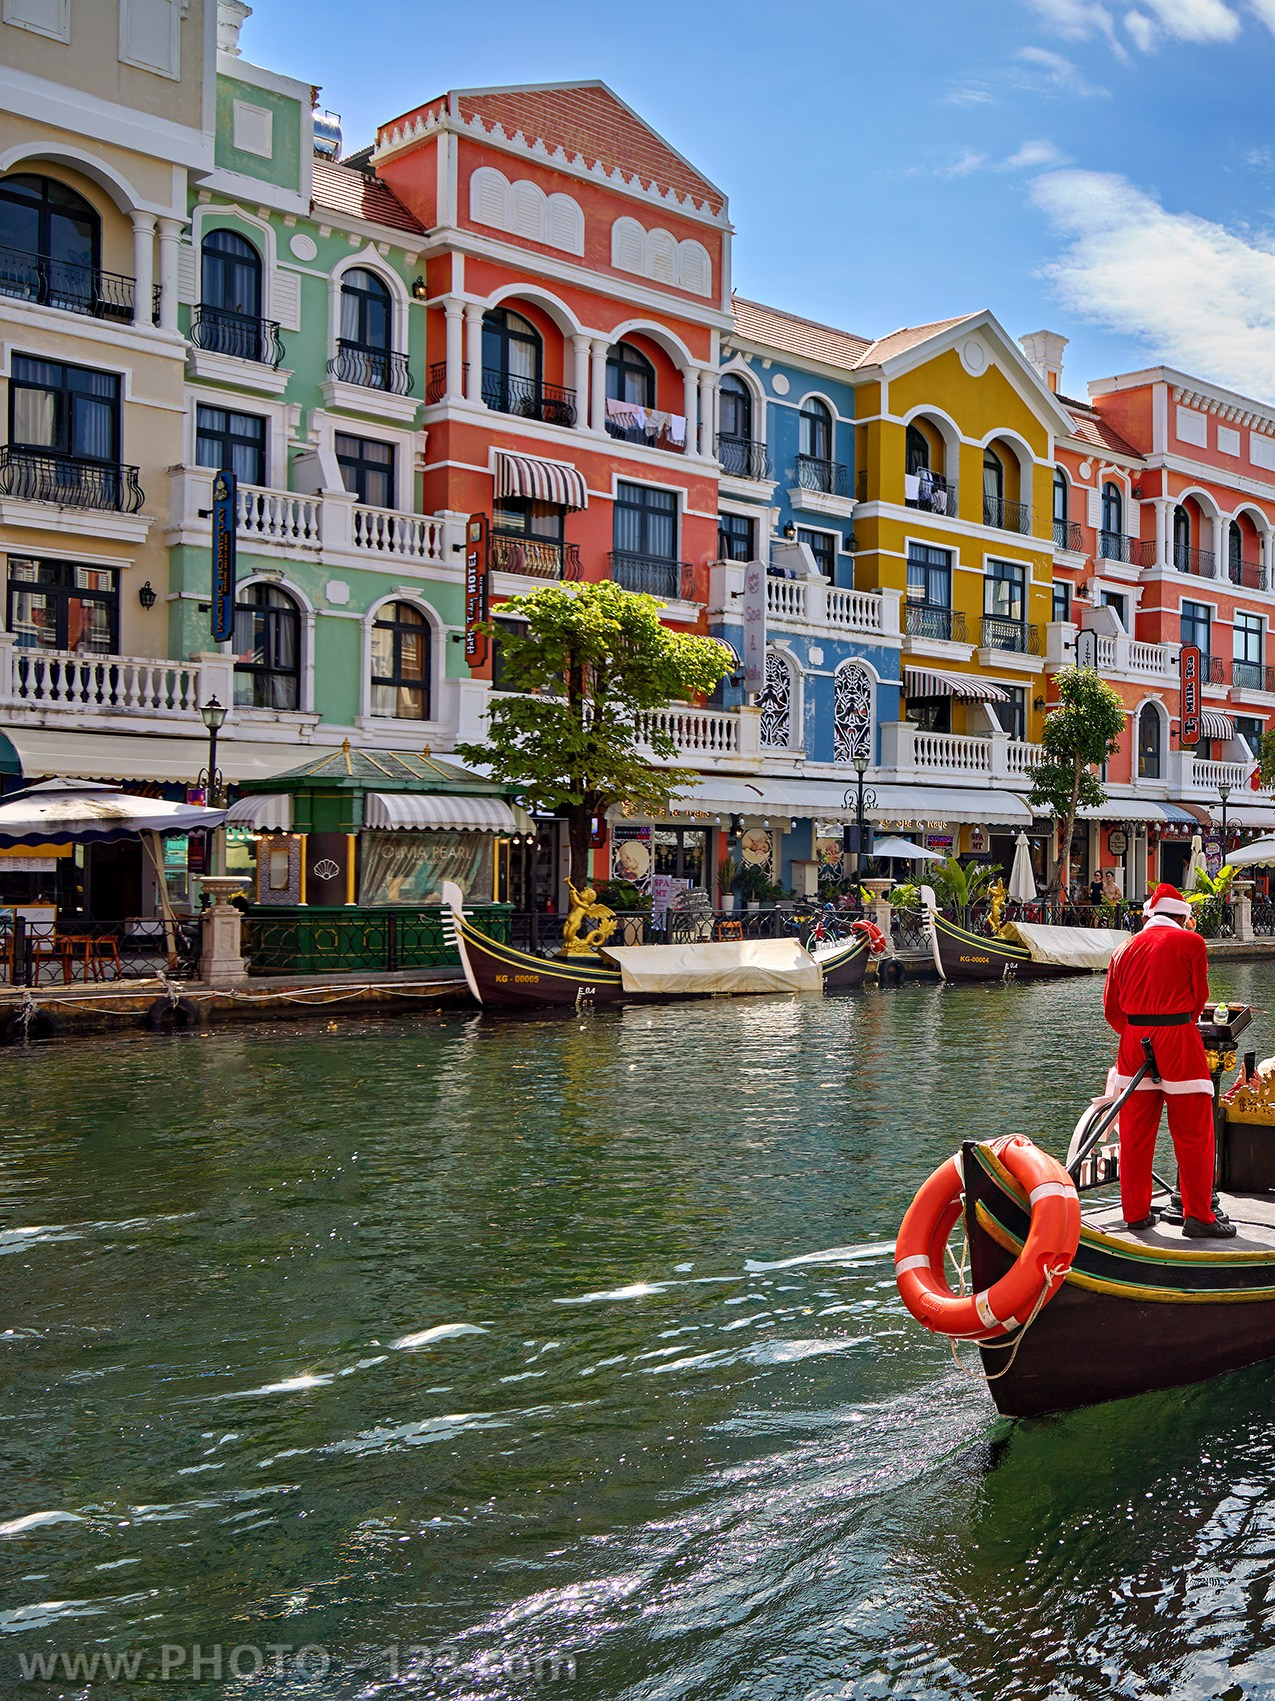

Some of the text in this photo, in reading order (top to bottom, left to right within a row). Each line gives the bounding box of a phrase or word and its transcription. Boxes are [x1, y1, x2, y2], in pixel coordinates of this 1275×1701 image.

[216, 506, 225, 633] PACIFIC HOMESTAY
[468, 551, 477, 594] HOTEL
[746, 606, 761, 622] Spa
[1185, 656, 1195, 679] Tea
[1185, 681, 1195, 714] Milk
[432, 845, 472, 859] PEARL
[654, 879, 669, 887] SPA
[656, 889, 667, 897] MT
[495, 974, 508, 983] KG
[514, 975, 540, 983] 00005
